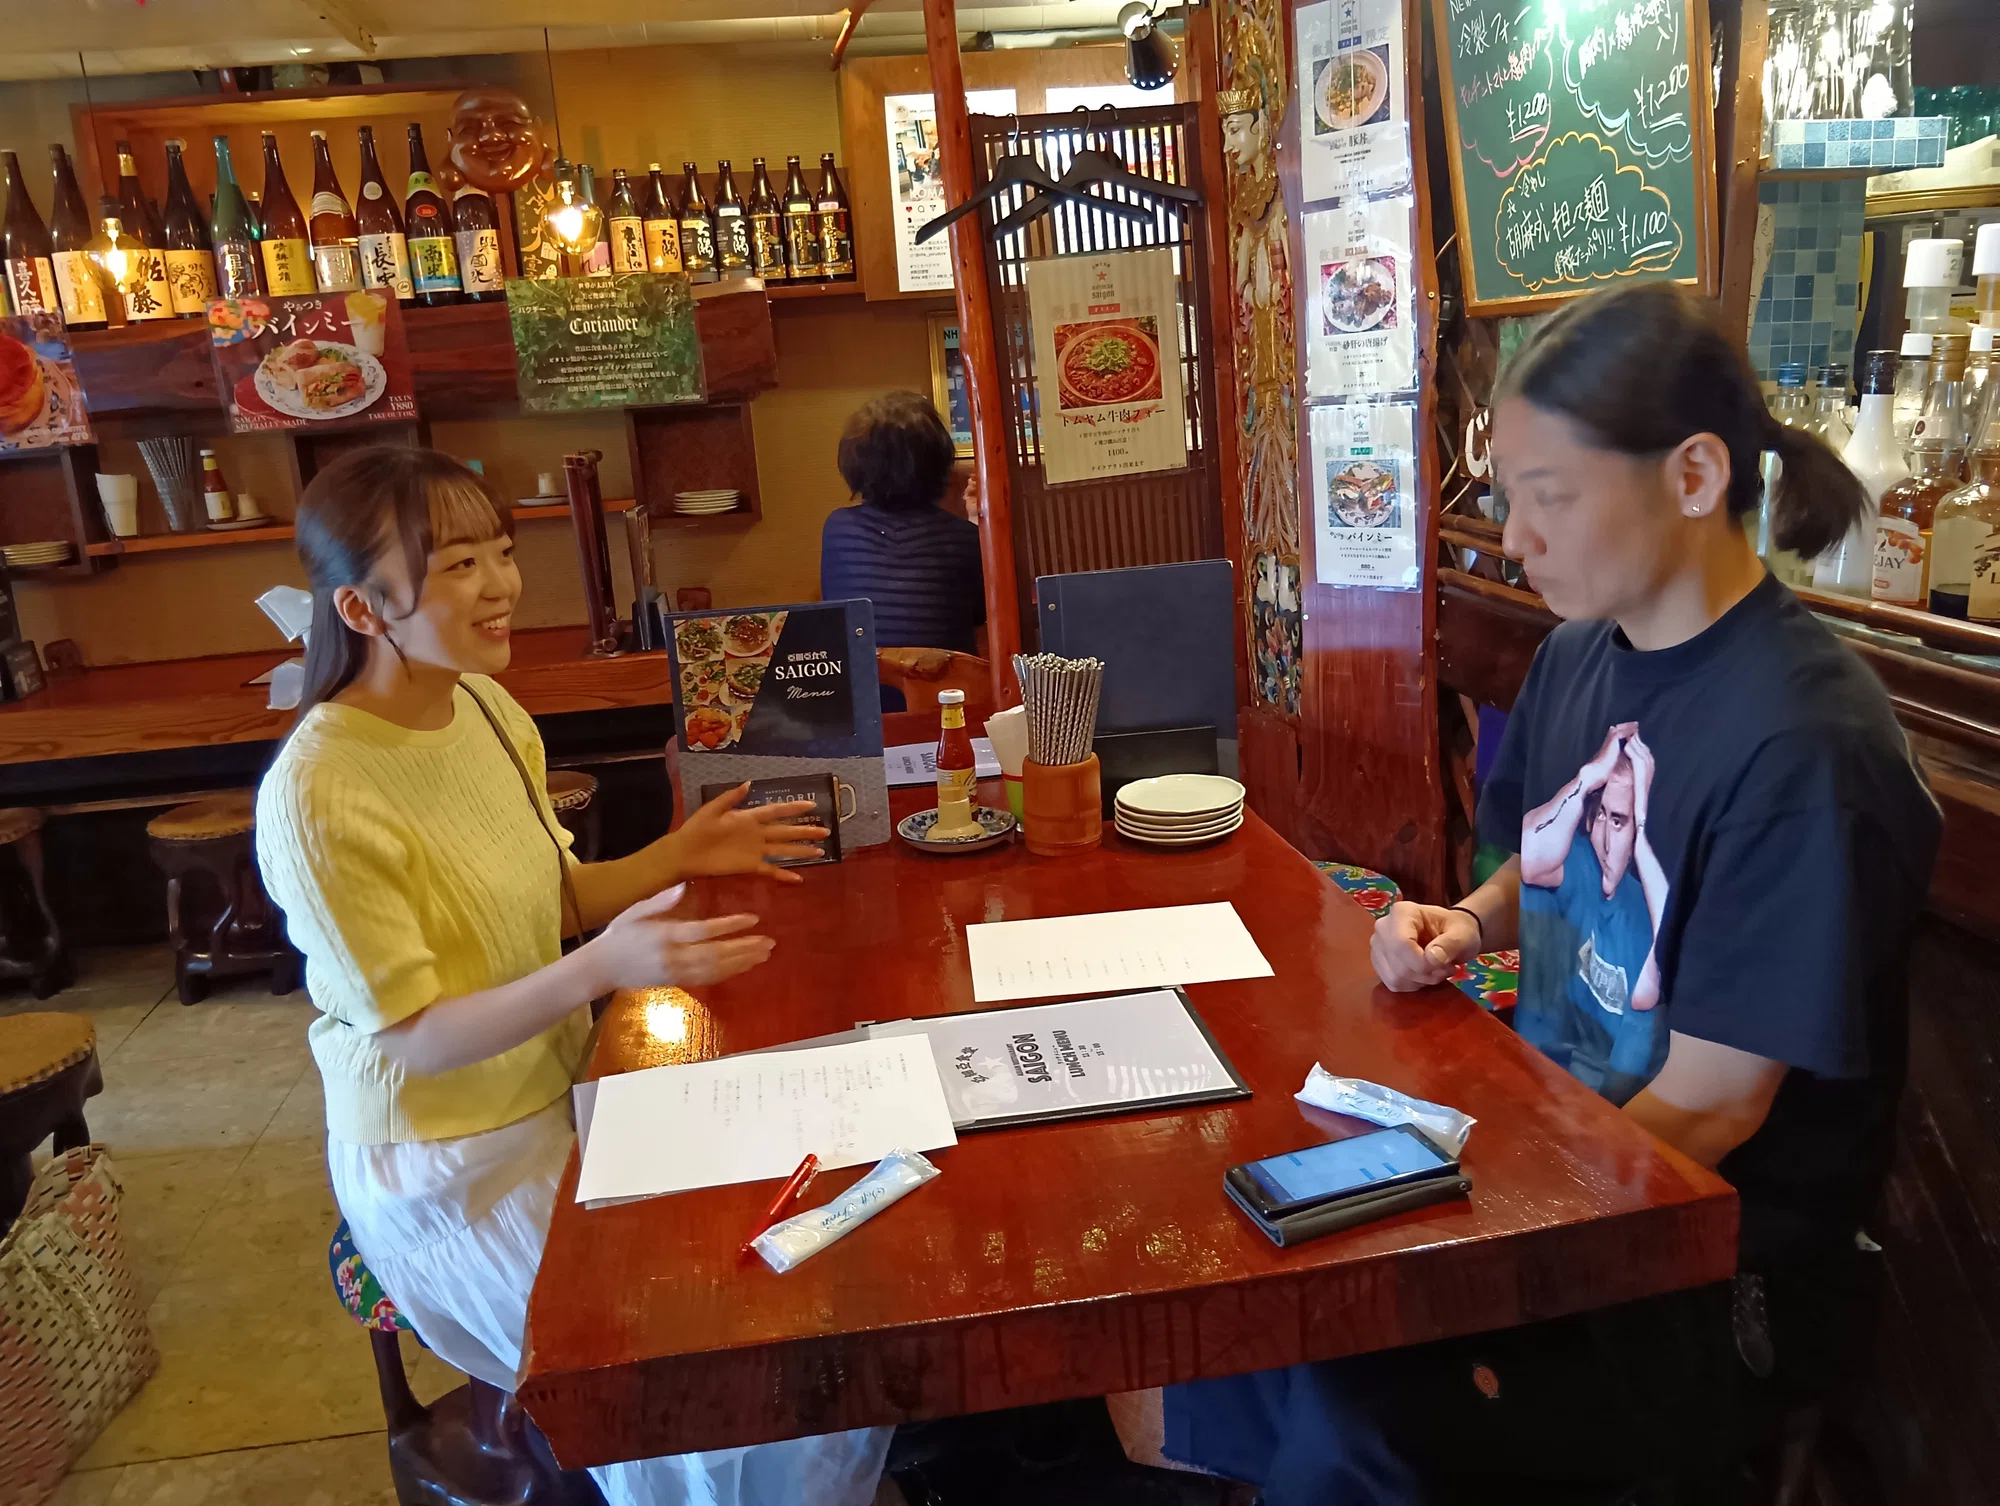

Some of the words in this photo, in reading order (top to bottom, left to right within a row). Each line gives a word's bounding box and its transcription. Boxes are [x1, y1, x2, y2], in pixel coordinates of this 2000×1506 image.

[1616, 206, 1668, 254] ¥1,100
[518, 306, 546, 314] パクチー
[251, 311, 363, 339] バインミー
[569, 316, 639, 335] Coriander
[1061, 408, 1166, 428] トムヤム牛肉フォー
[1347, 531, 1393, 542] バインミー
[775, 660, 842, 680] SAIGON
[787, 685, 835, 699] Menu
[1052, 1030, 1076, 1052] MENU
[1012, 1033, 1052, 1083] SAIGON
[1062, 1052, 1085, 1078] LUNCH
